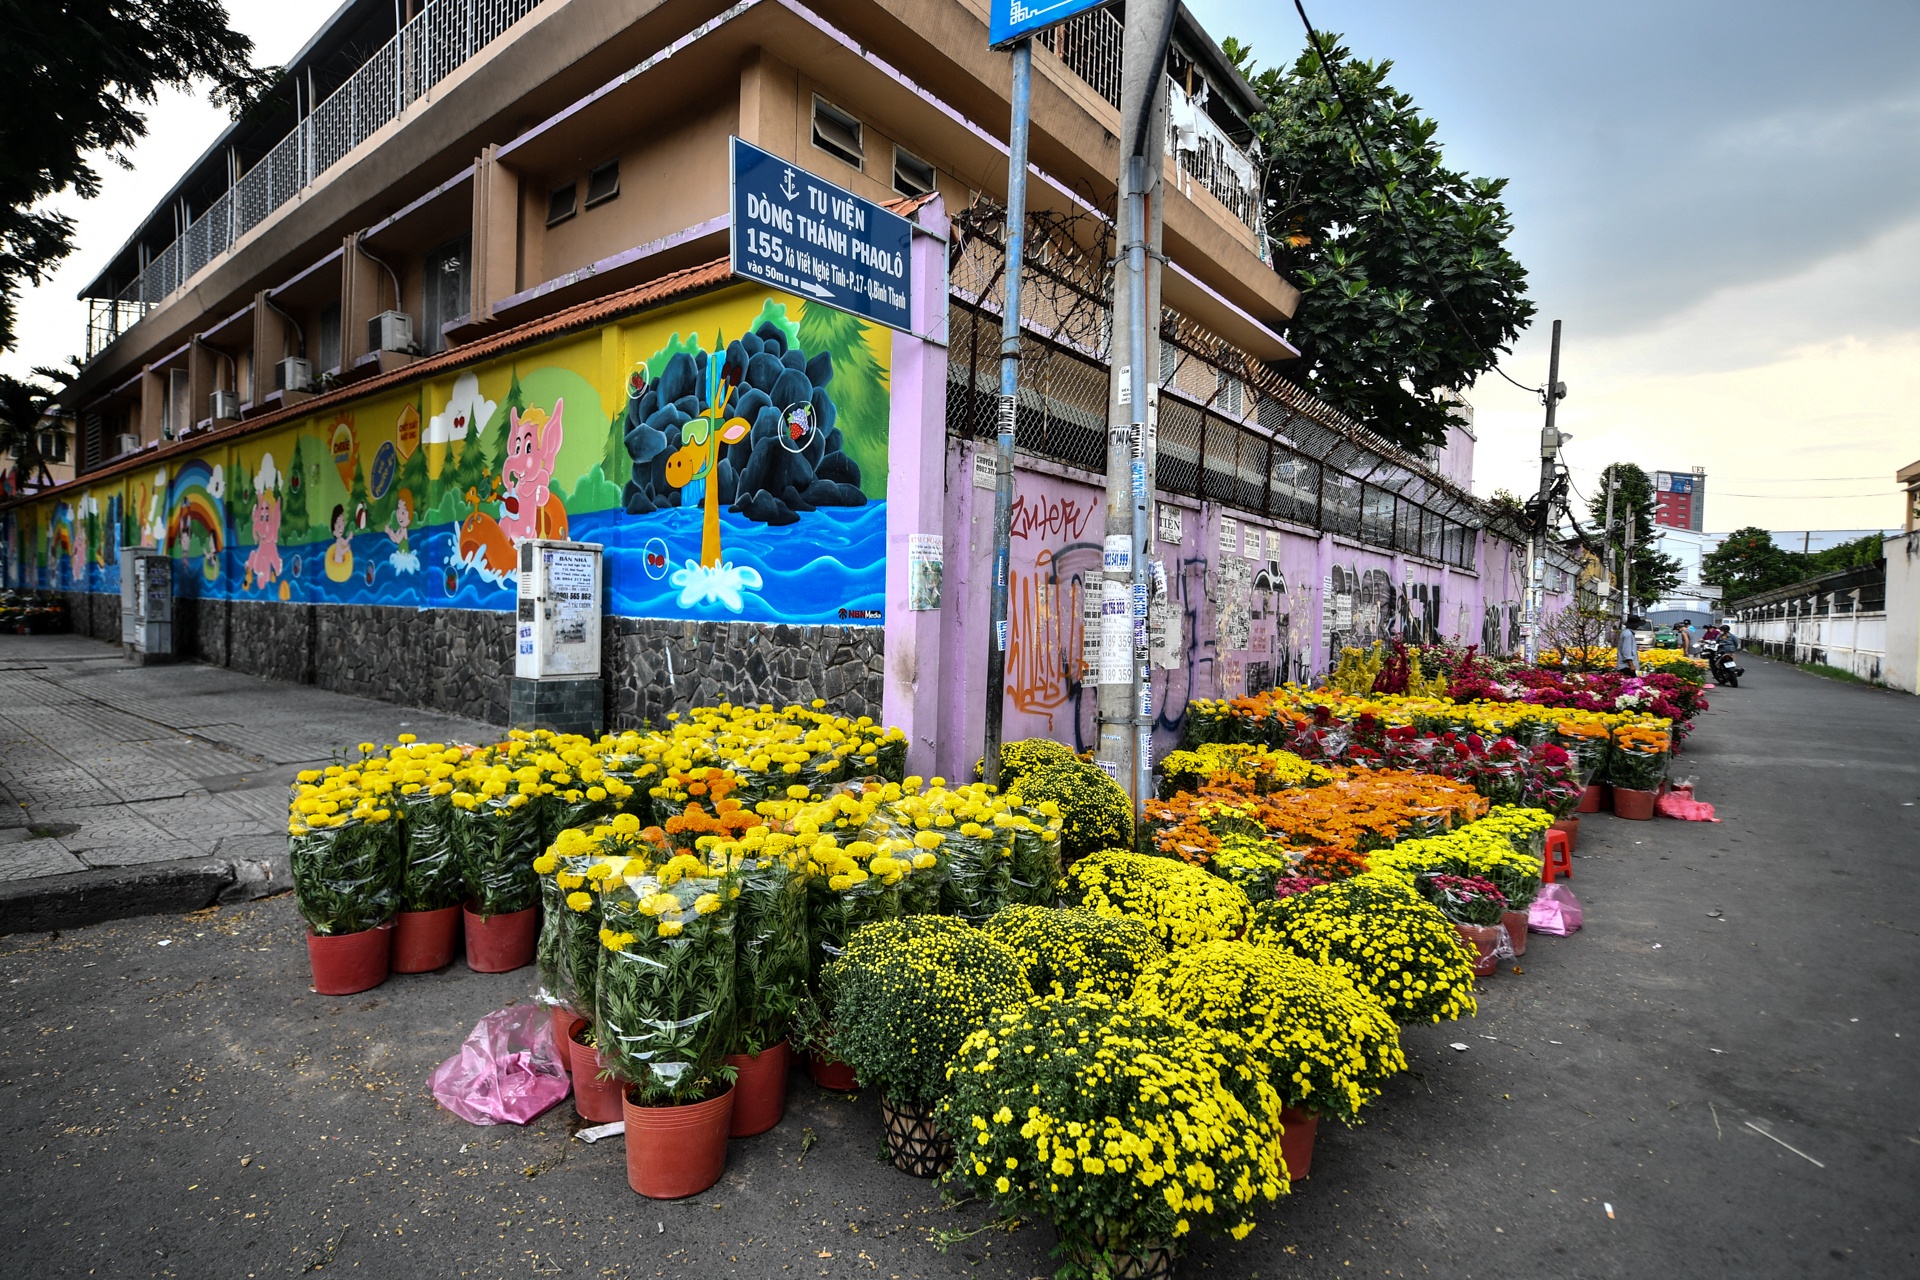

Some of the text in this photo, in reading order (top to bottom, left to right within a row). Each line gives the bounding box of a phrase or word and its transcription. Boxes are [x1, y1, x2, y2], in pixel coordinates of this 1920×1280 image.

[808, 185, 865, 232] TU VIỆN
[747, 192, 903, 278] DÒNG THÁNH PHAOLÔ
[747, 228, 784, 263] 155
[785, 245, 795, 269] Xô
[797, 250, 811, 275] Viết
[812, 256, 830, 286] Nghệ
[888, 286, 906, 310] Thạnh
[747, 260, 784, 283] vào 50m
[1118, 669, 1132, 681] 359
